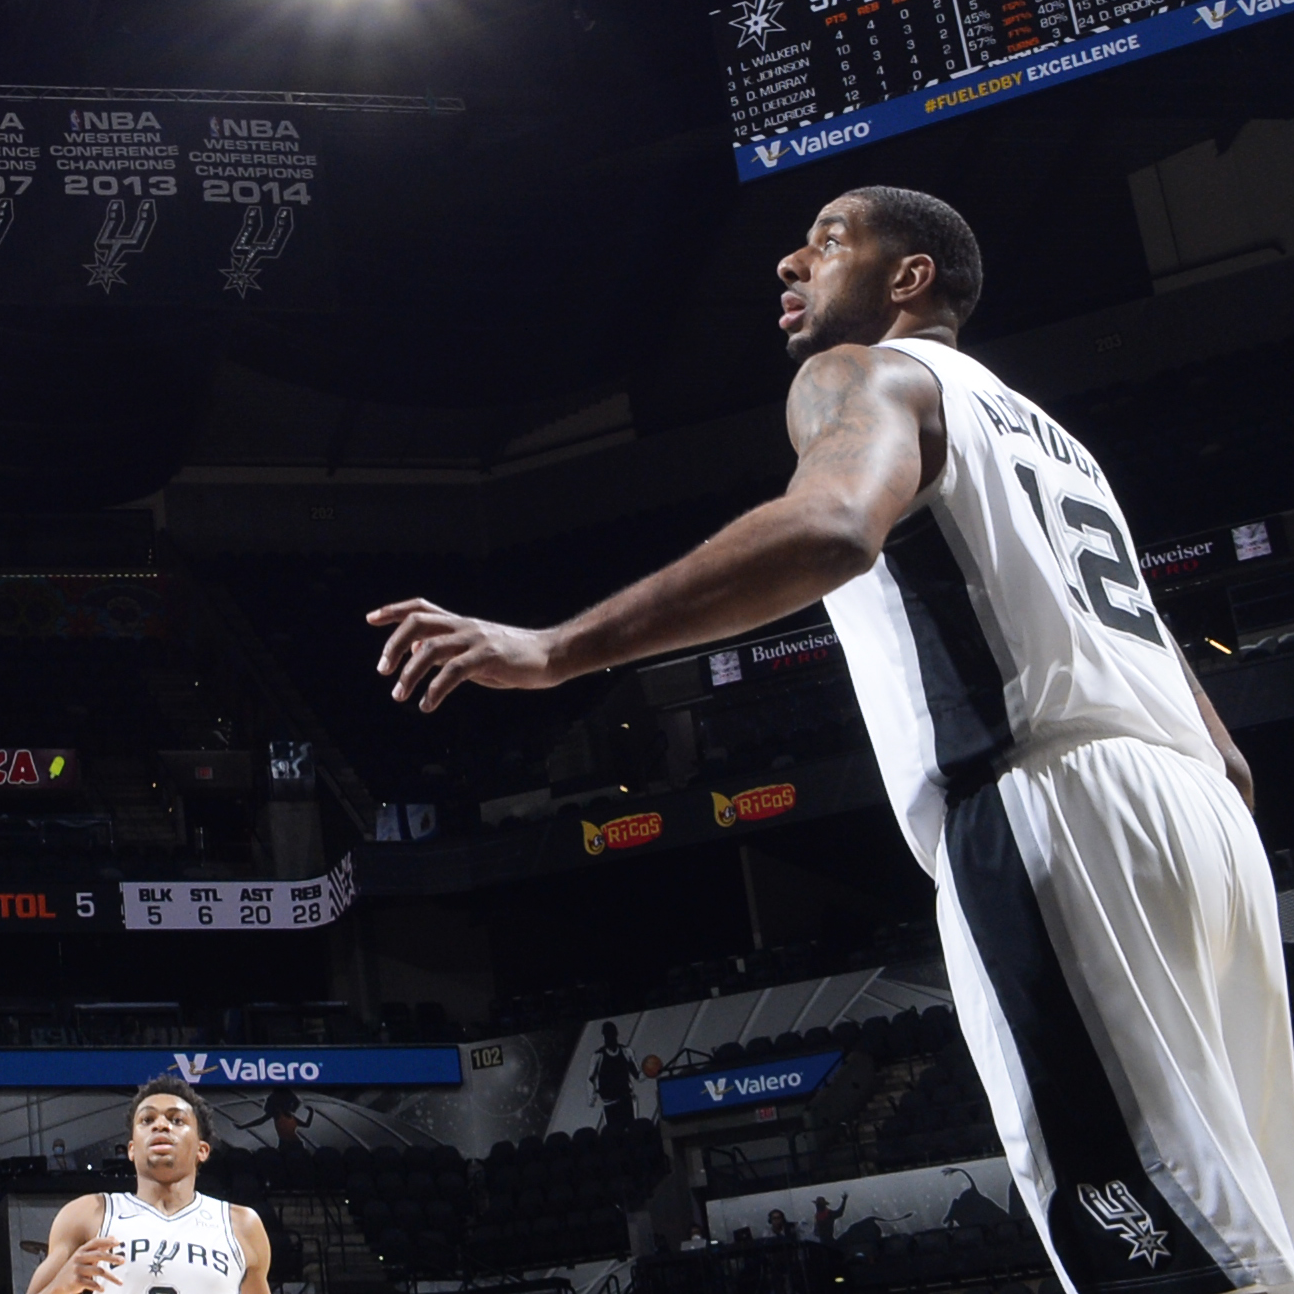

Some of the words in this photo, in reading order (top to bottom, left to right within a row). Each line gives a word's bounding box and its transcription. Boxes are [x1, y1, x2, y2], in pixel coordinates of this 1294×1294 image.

[1076, 0, 1091, 12] 15
[1079, 15, 1095, 28] 24
[751, 43, 800, 68] WALKER
[756, 57, 811, 82] JOHNSON
[836, 44, 852, 56] 10
[730, 96, 739, 107] 5
[760, 73, 809, 98] MURRAY
[840, 60, 850, 71] 6
[790, 122, 871, 156] Valero
[924, 71, 1023, 113] #FUELEDBY
[1026, 34, 1141, 81] EXCELLENCE
[731, 110, 747, 122] 10
[841, 75, 857, 87] 12
[83, 111, 162, 130] NBA
[733, 125, 748, 137] 12
[844, 90, 861, 103] 12
[64, 132, 161, 144] WESTERN
[222, 119, 300, 139] NBA
[50, 145, 179, 157] CONFERENCE
[203, 139, 299, 152] WESTERN
[57, 159, 176, 171] CHAMPIONS
[189, 152, 318, 166] CONFERENCE
[195, 165, 314, 180] CHAMPIONS
[64, 176, 178, 196] 2013
[202, 180, 311, 205] 2014
[1012, 458, 1174, 651] 12
[1140, 541, 1213, 569] dweiser
[75, 892, 95, 918] 5
[138, 888, 174, 903] BLK
[190, 888, 223, 903] STL
[239, 888, 275, 903] AST
[290, 884, 323, 902] REB
[147, 905, 163, 926] 5
[197, 905, 214, 926] 6
[239, 905, 272, 925] 20
[292, 903, 322, 925] 28
[220, 1056, 320, 1082] Valero
[471, 1046, 503, 1069] 102
[733, 1070, 802, 1097] Valero
